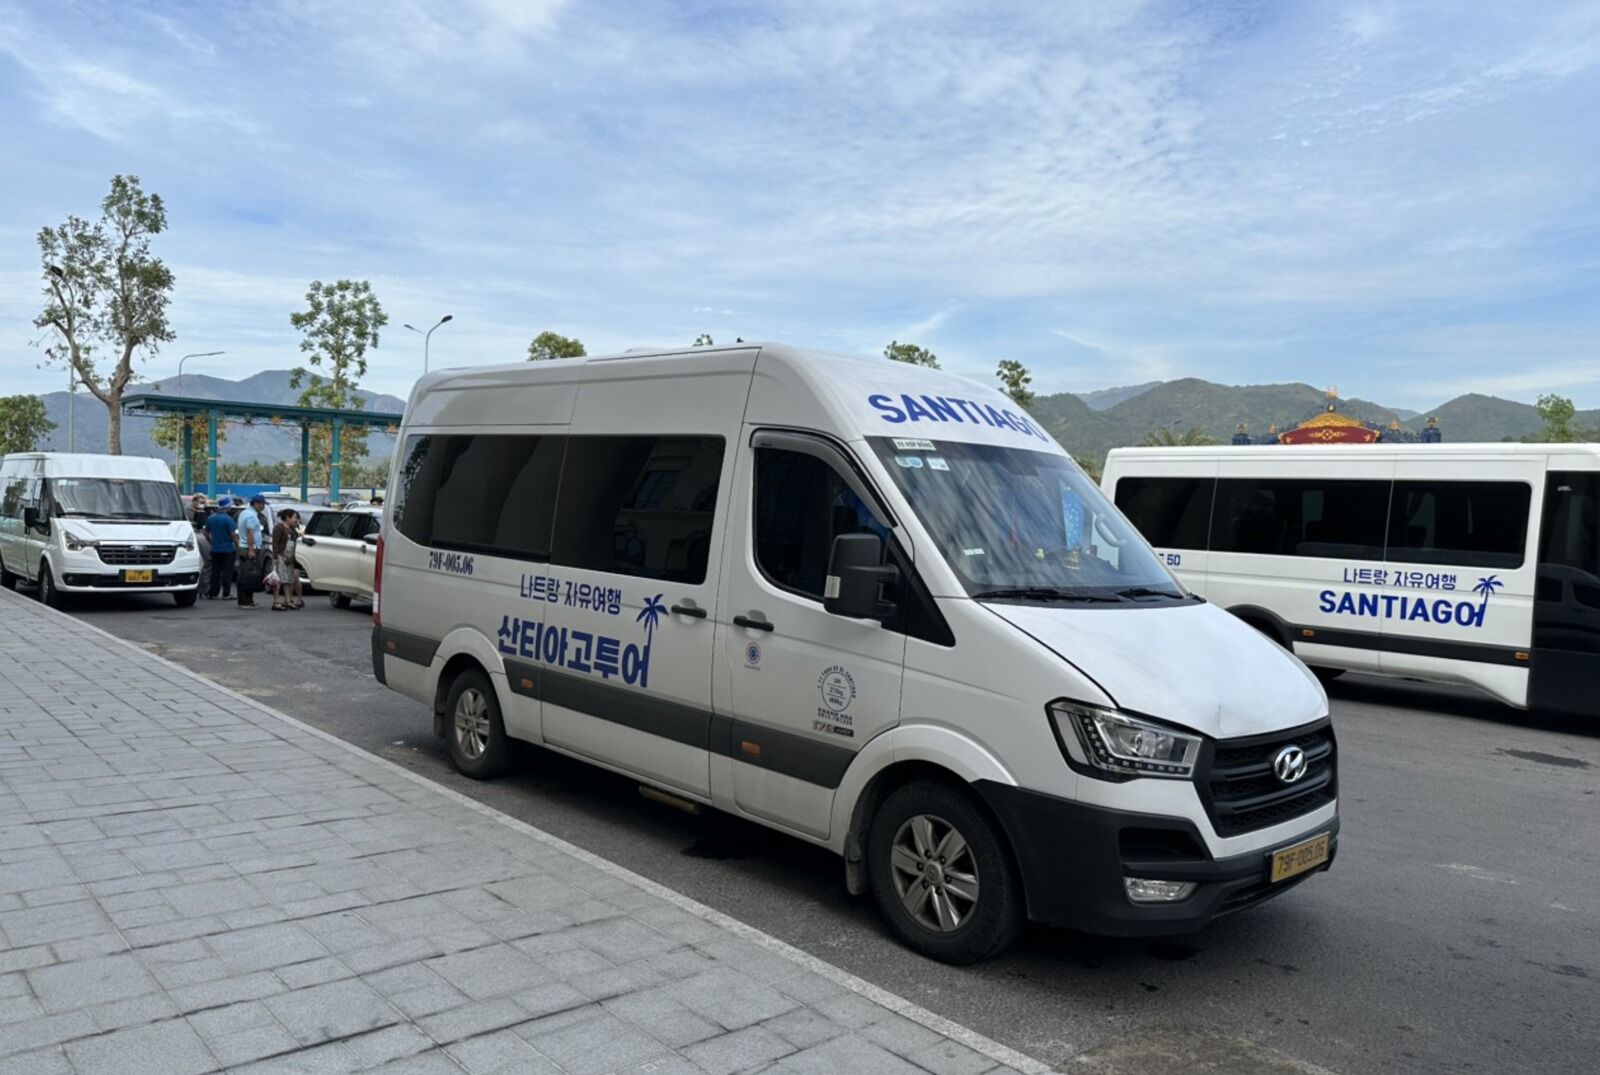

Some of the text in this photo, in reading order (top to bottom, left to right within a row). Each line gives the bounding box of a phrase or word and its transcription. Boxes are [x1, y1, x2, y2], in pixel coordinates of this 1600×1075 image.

[868, 394, 1049, 443] SANTIAGO
[429, 551, 474, 576] 79F-005.06
[1166, 553, 1181, 566] 50
[520, 574, 622, 615] 나트랑 자유여행
[1343, 567, 1457, 591] 나트랑 자유여행
[1319, 590, 1479, 627] SANTIAGO
[497, 615, 651, 688] 산티아고투어
